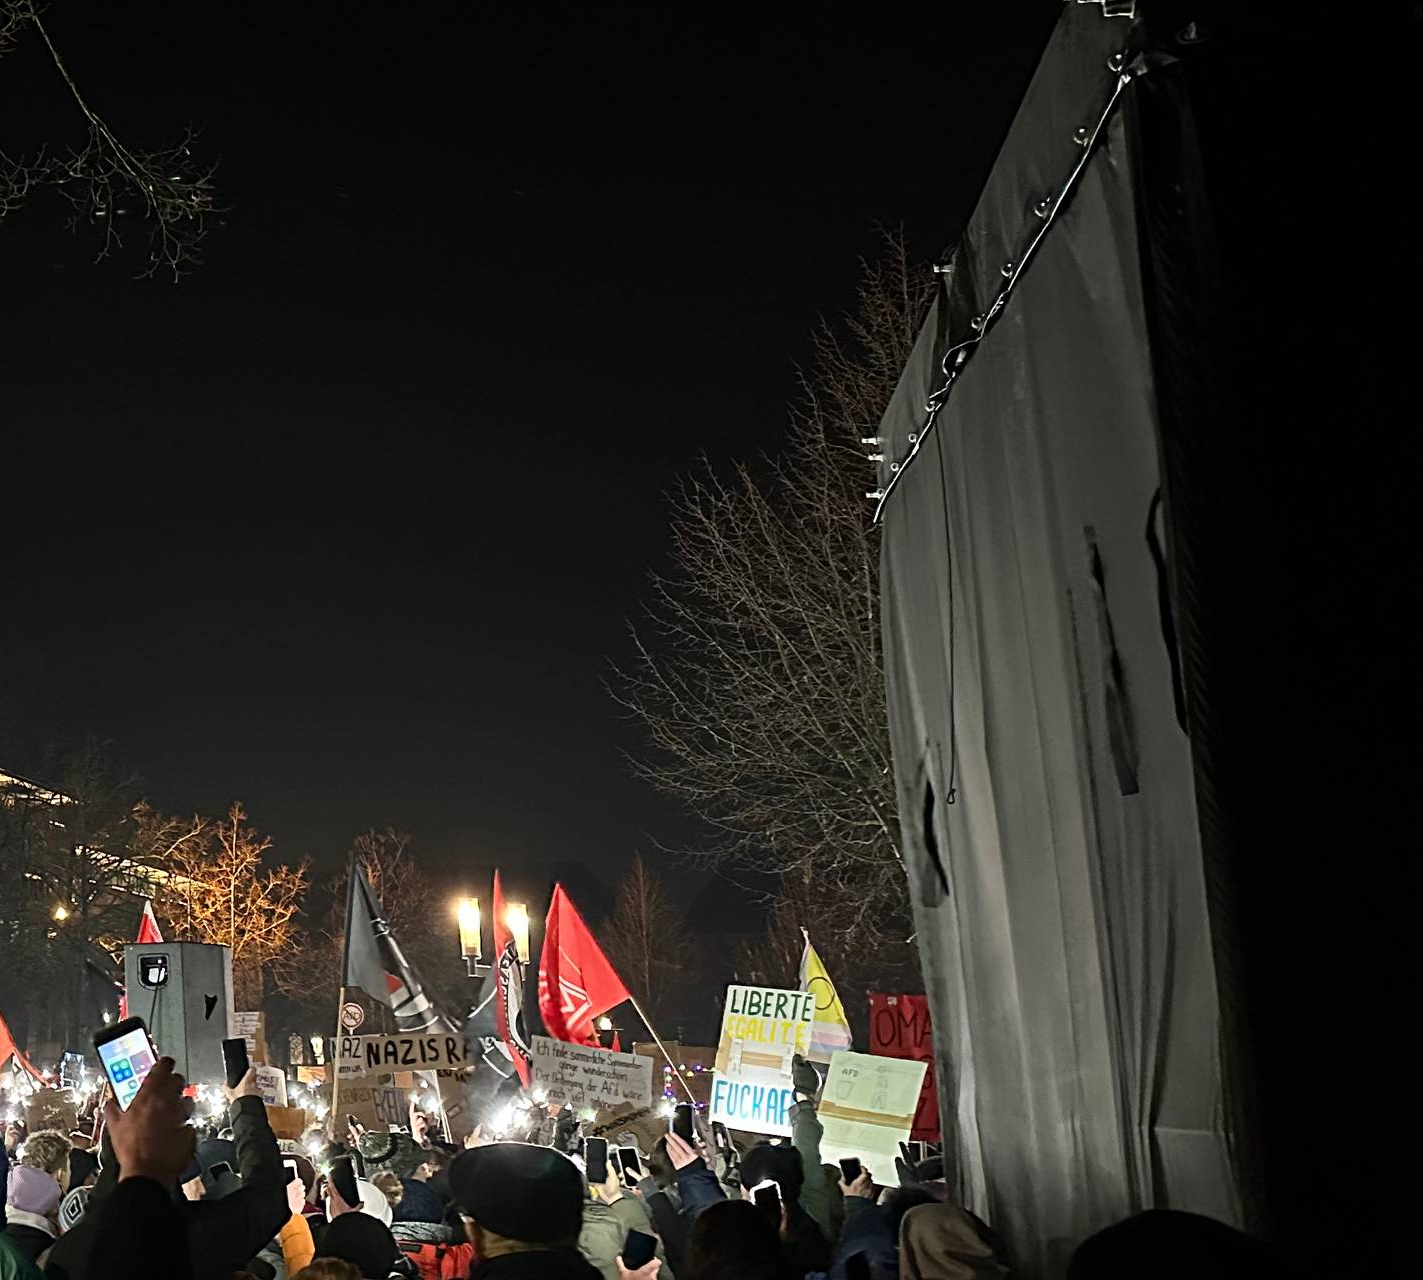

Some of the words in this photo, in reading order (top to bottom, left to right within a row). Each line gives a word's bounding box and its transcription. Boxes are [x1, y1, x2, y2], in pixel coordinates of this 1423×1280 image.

[730, 989, 814, 1022] LIBERTÉ
[366, 1038, 439, 1068] NAZIS
[713, 1080, 793, 1126] FUCKAF
